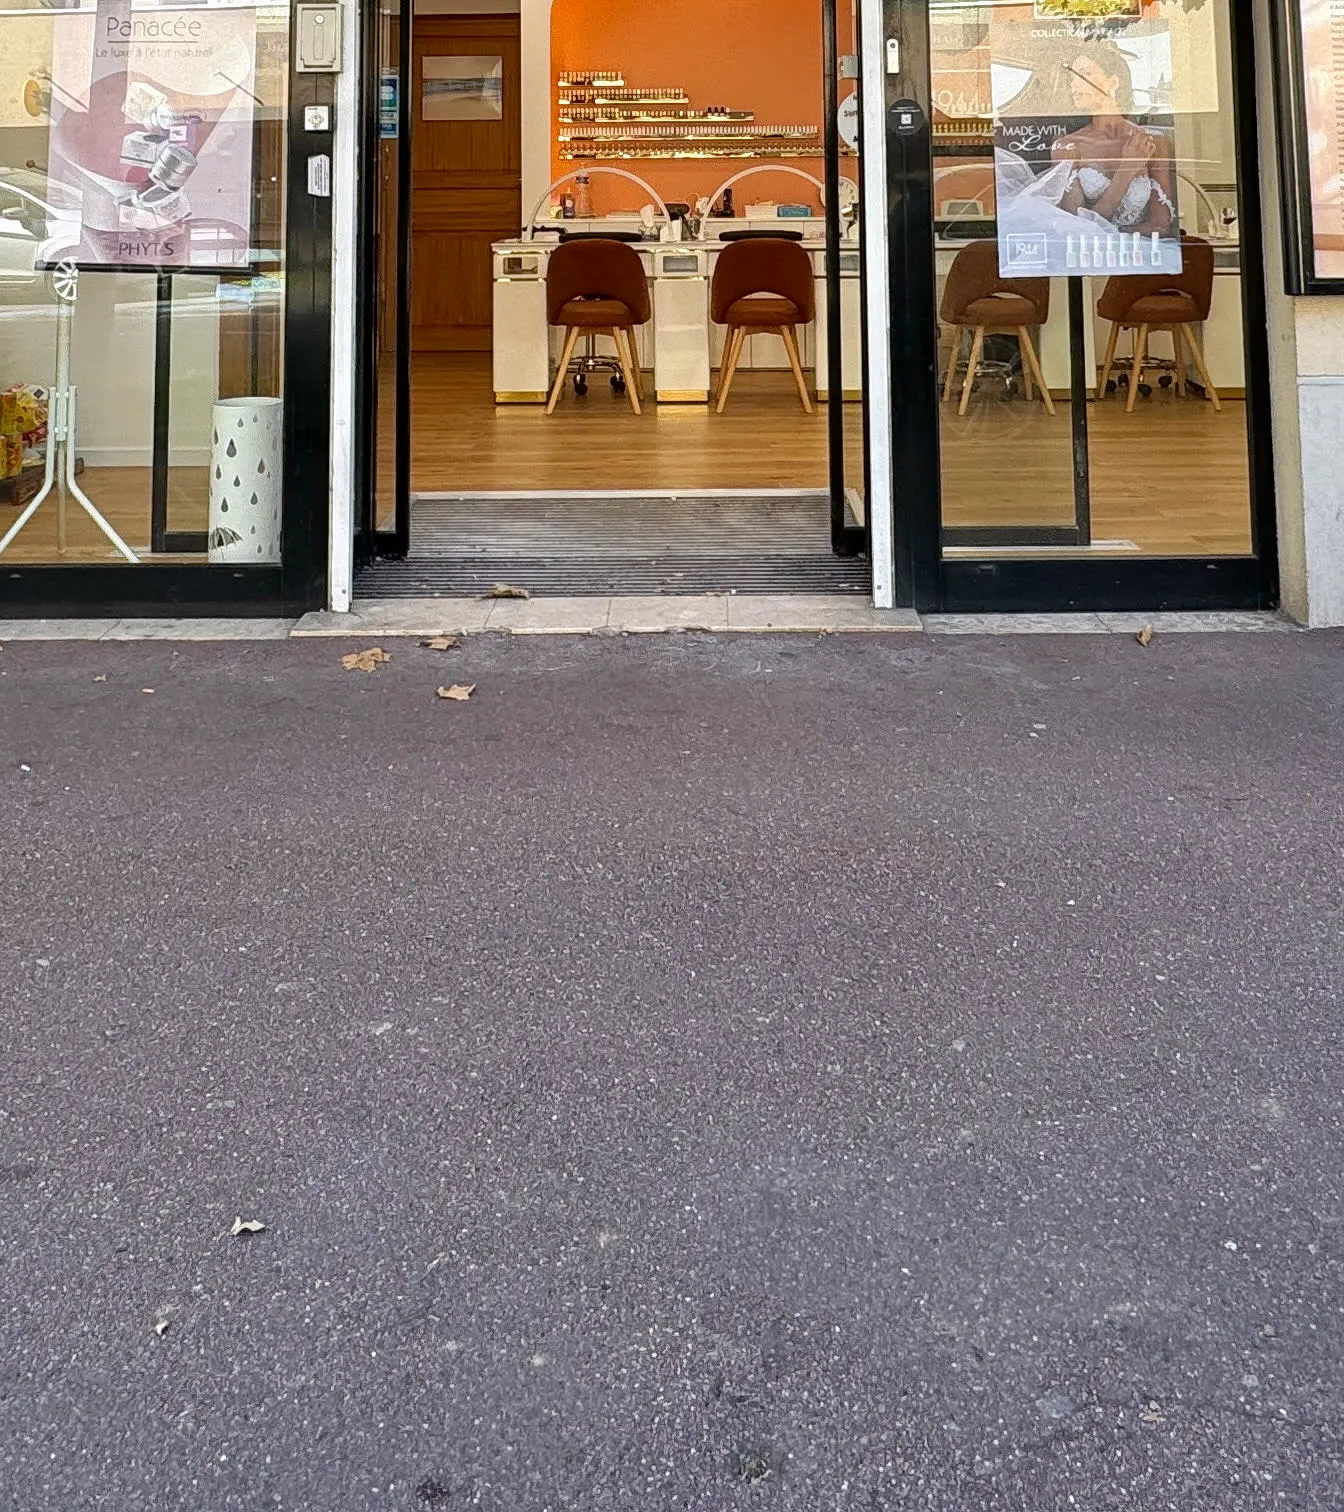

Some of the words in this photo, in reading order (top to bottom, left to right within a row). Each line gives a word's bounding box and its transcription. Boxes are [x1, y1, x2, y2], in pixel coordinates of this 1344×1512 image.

[106, 15, 202, 37] Panacée
[95, 47, 108, 58] Le
[1002, 124, 1035, 137] MADE
[1036, 124, 1067, 136] WITH
[1008, 134, 1078, 153] Love
